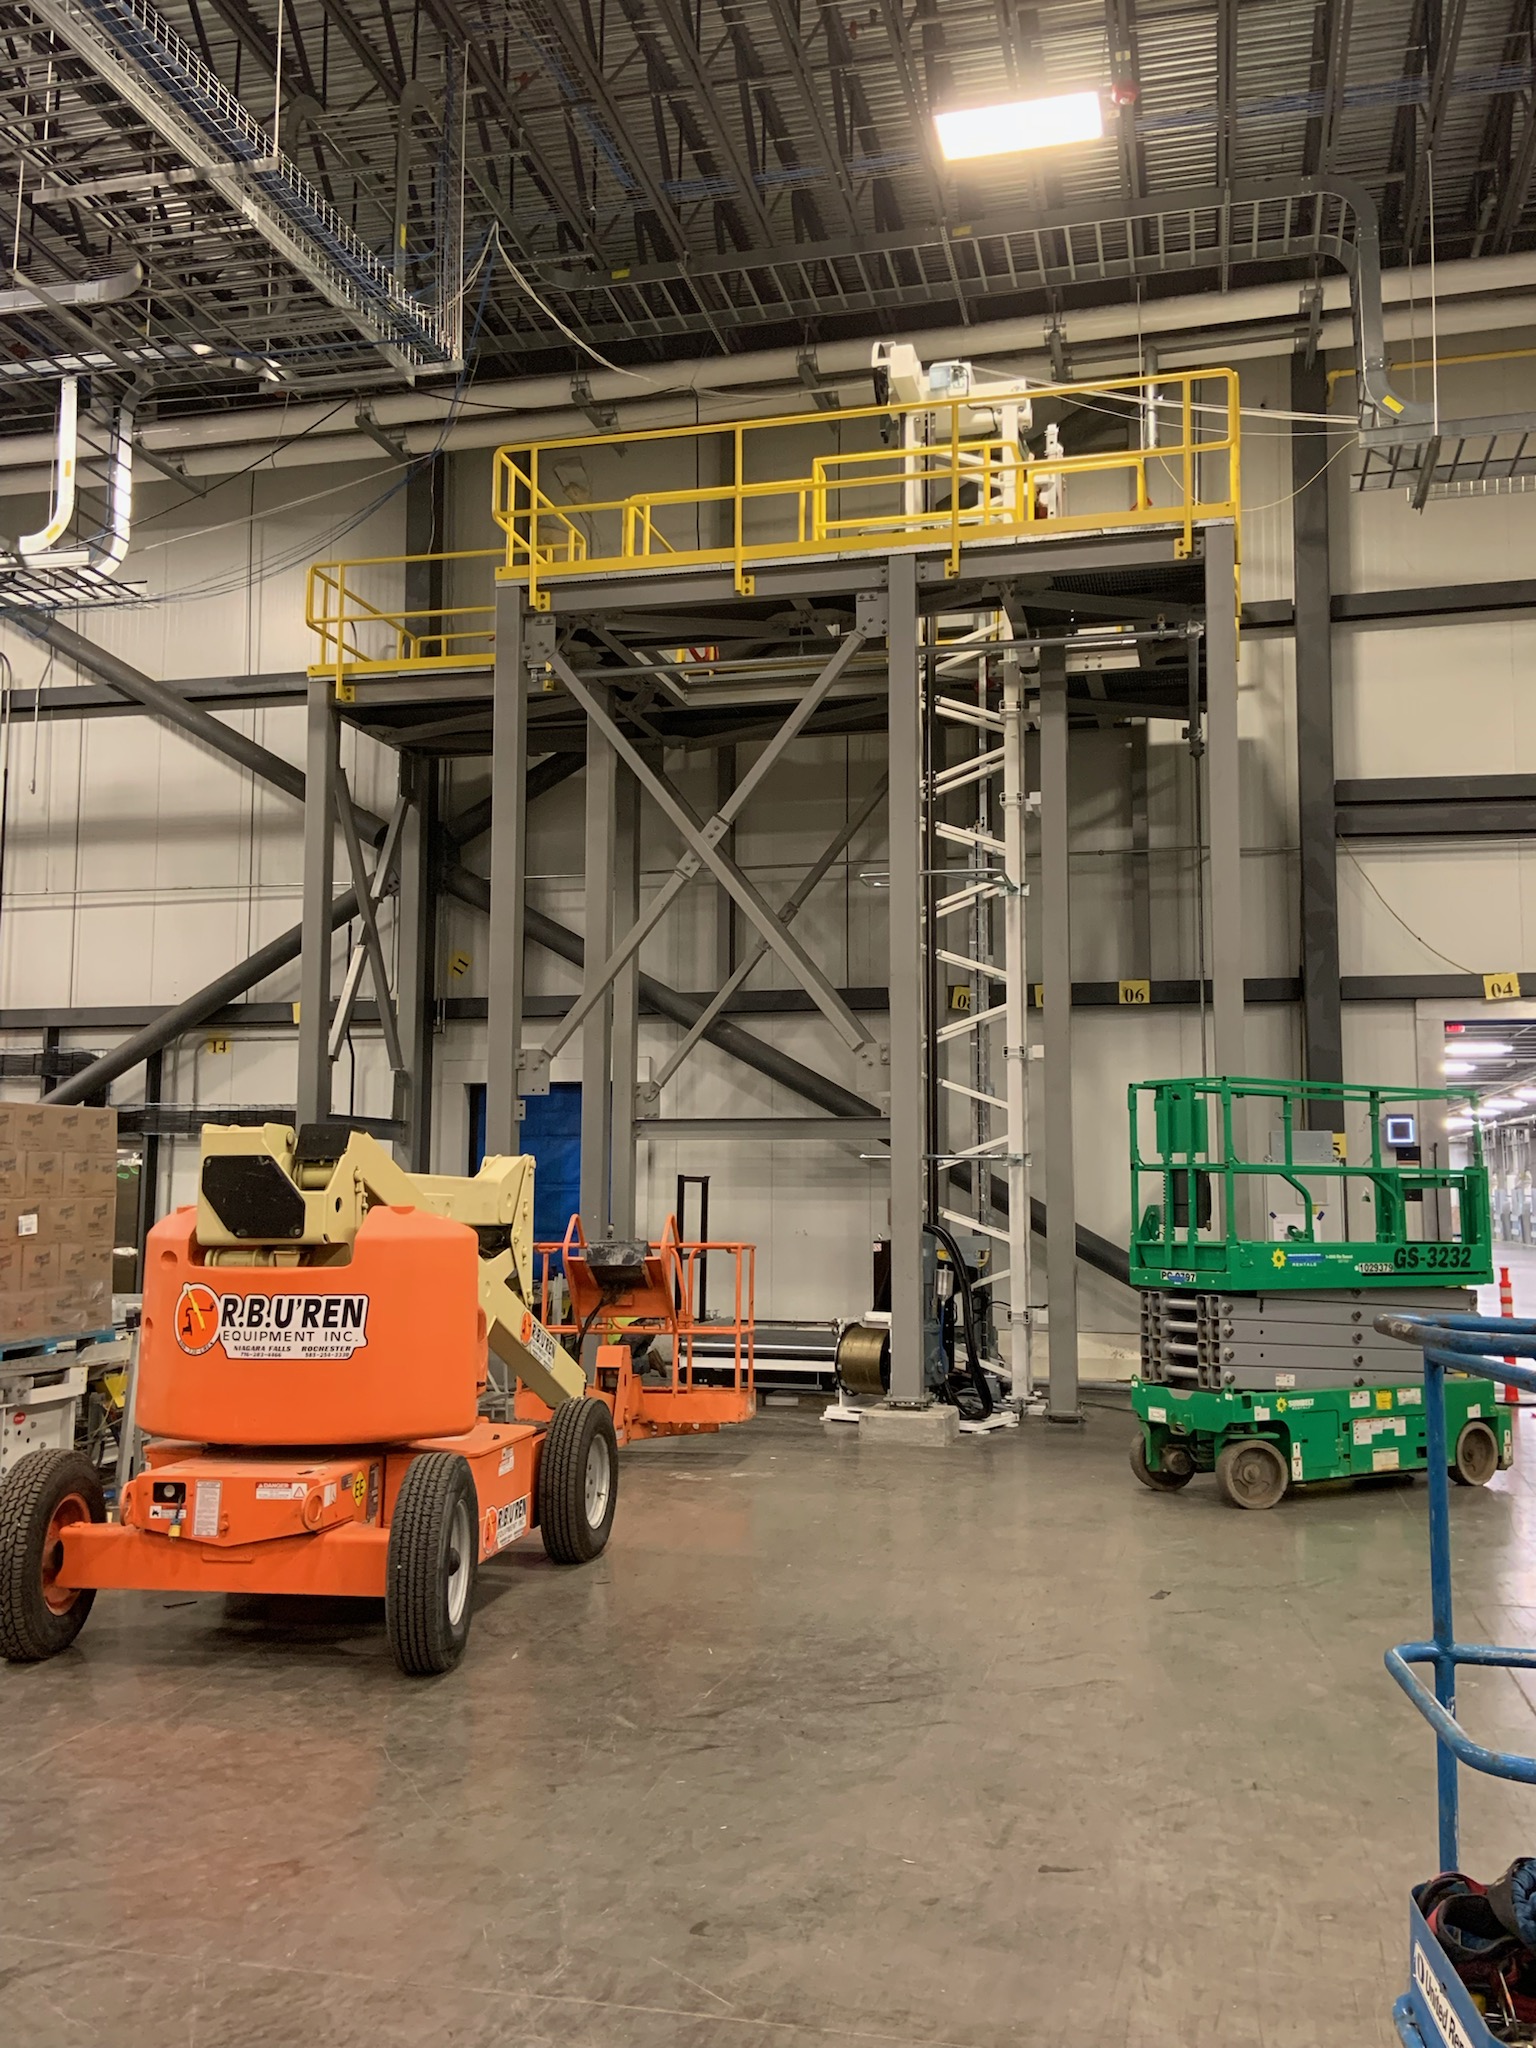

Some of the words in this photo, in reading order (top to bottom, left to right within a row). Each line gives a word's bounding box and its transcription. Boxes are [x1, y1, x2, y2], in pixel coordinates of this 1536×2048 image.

[453, 958, 469, 975] 11
[1124, 986, 1145, 1003] 06
[1491, 981, 1514, 998] 04
[1332, 1142, 1341, 1157] 5
[1394, 1246, 1471, 1269] GS-3232
[1360, 1263, 1394, 1273] 1029379
[223, 1330, 315, 1342] EQUIPMENT
[325, 1331, 358, 1342] INC.
[354, 1479, 364, 1498] EE
[1425, 1969, 1449, 2033] United
